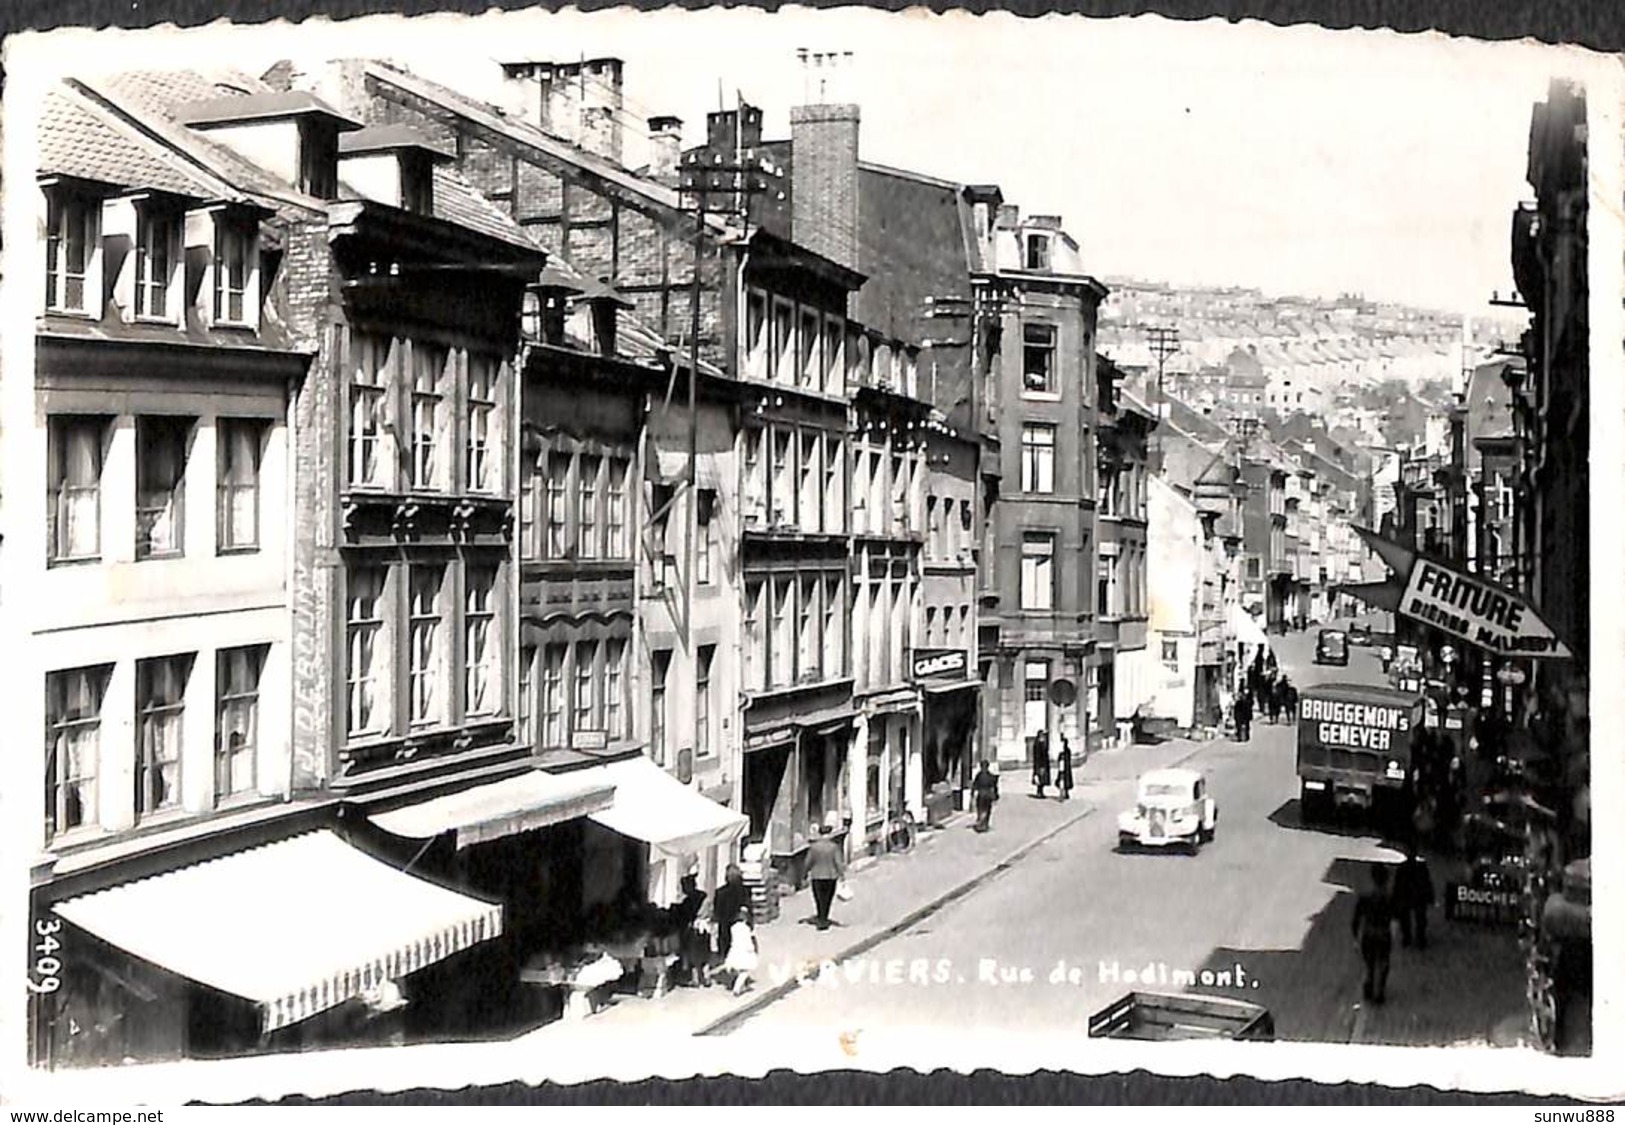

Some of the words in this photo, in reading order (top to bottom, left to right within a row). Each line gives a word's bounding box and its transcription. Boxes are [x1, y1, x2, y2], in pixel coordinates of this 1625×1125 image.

[1416, 564, 1526, 632] FRITURE
[914, 652, 964, 675] GLACES
[1301, 699, 1409, 731] BRUGGEMAN's
[1319, 722, 1391, 750] GENEVER
